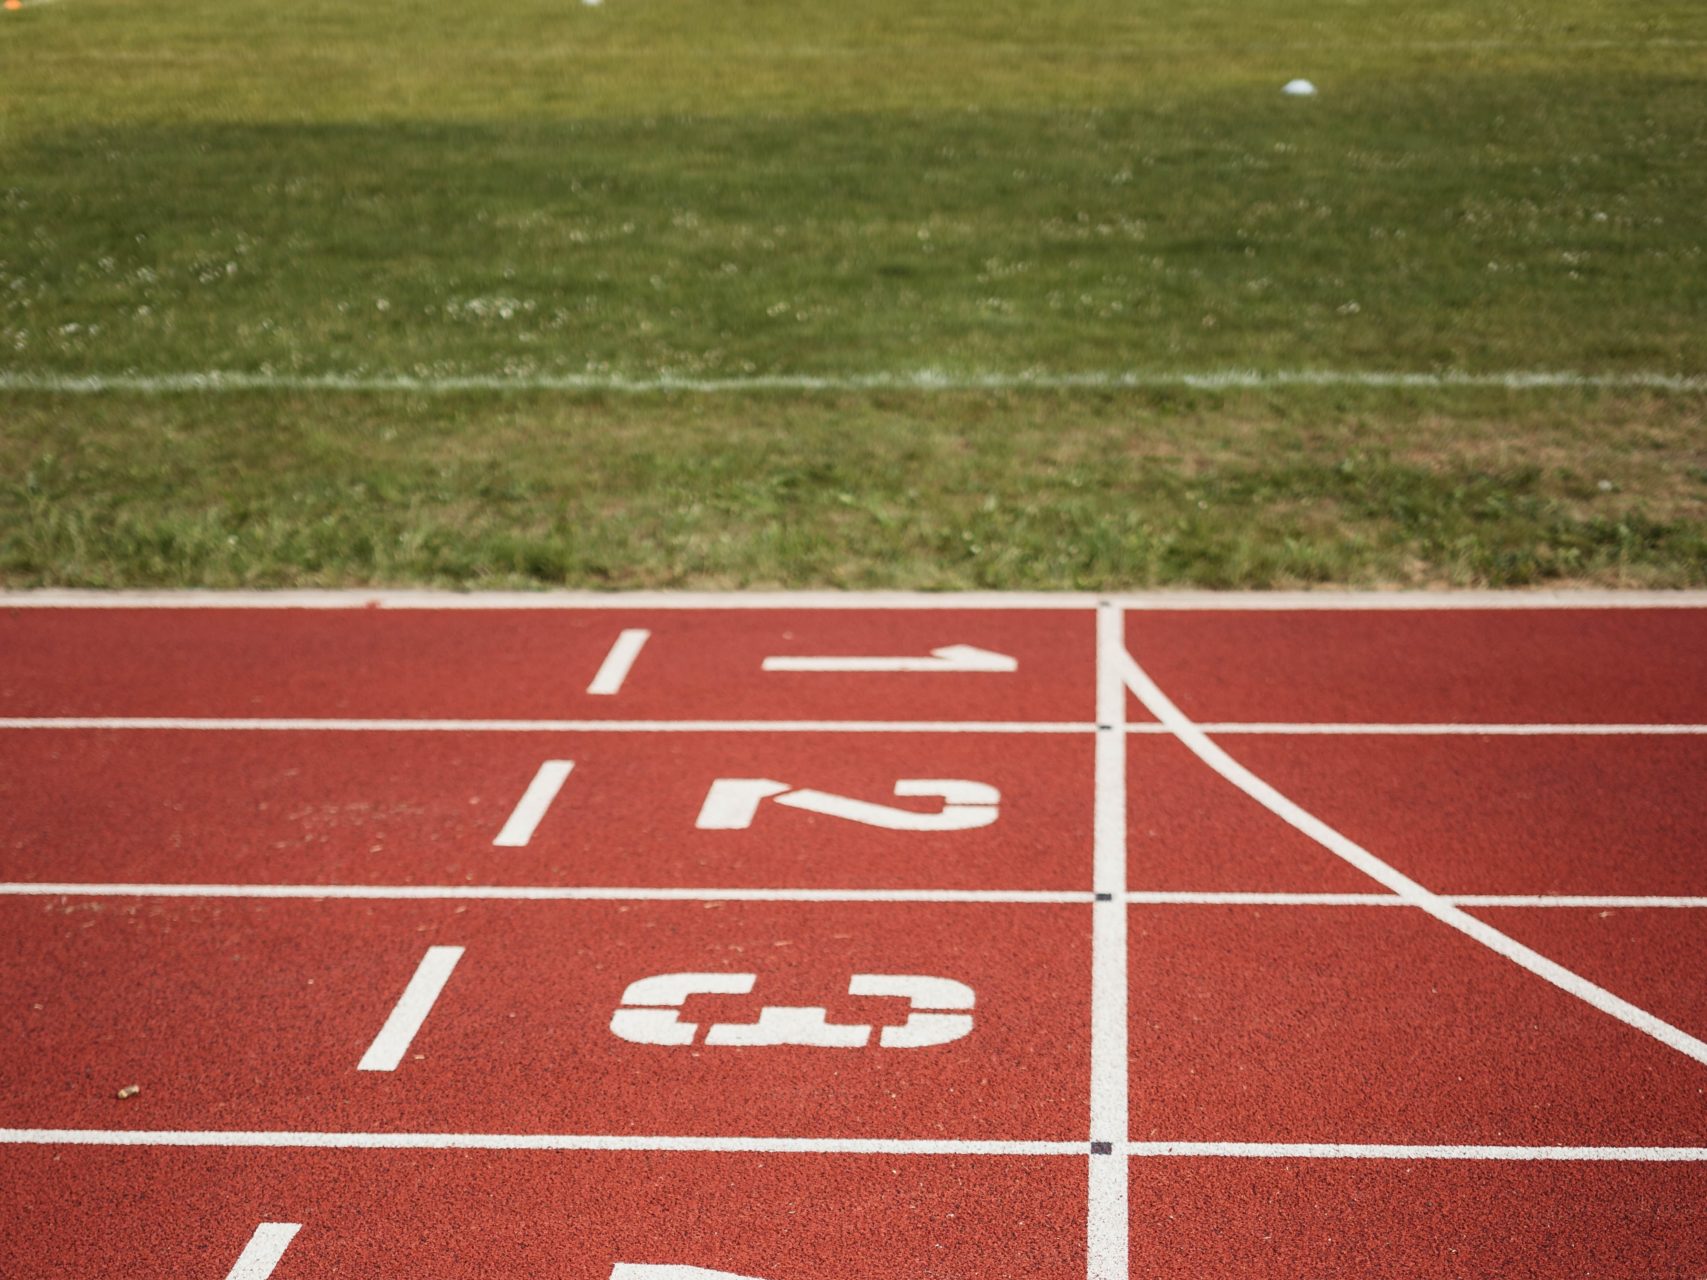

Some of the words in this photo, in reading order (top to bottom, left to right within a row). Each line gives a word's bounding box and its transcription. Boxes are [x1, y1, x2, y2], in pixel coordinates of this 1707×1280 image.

[761, 644, 1018, 672] 1
[695, 778, 1001, 831] 2
[609, 972, 976, 1049] 3
